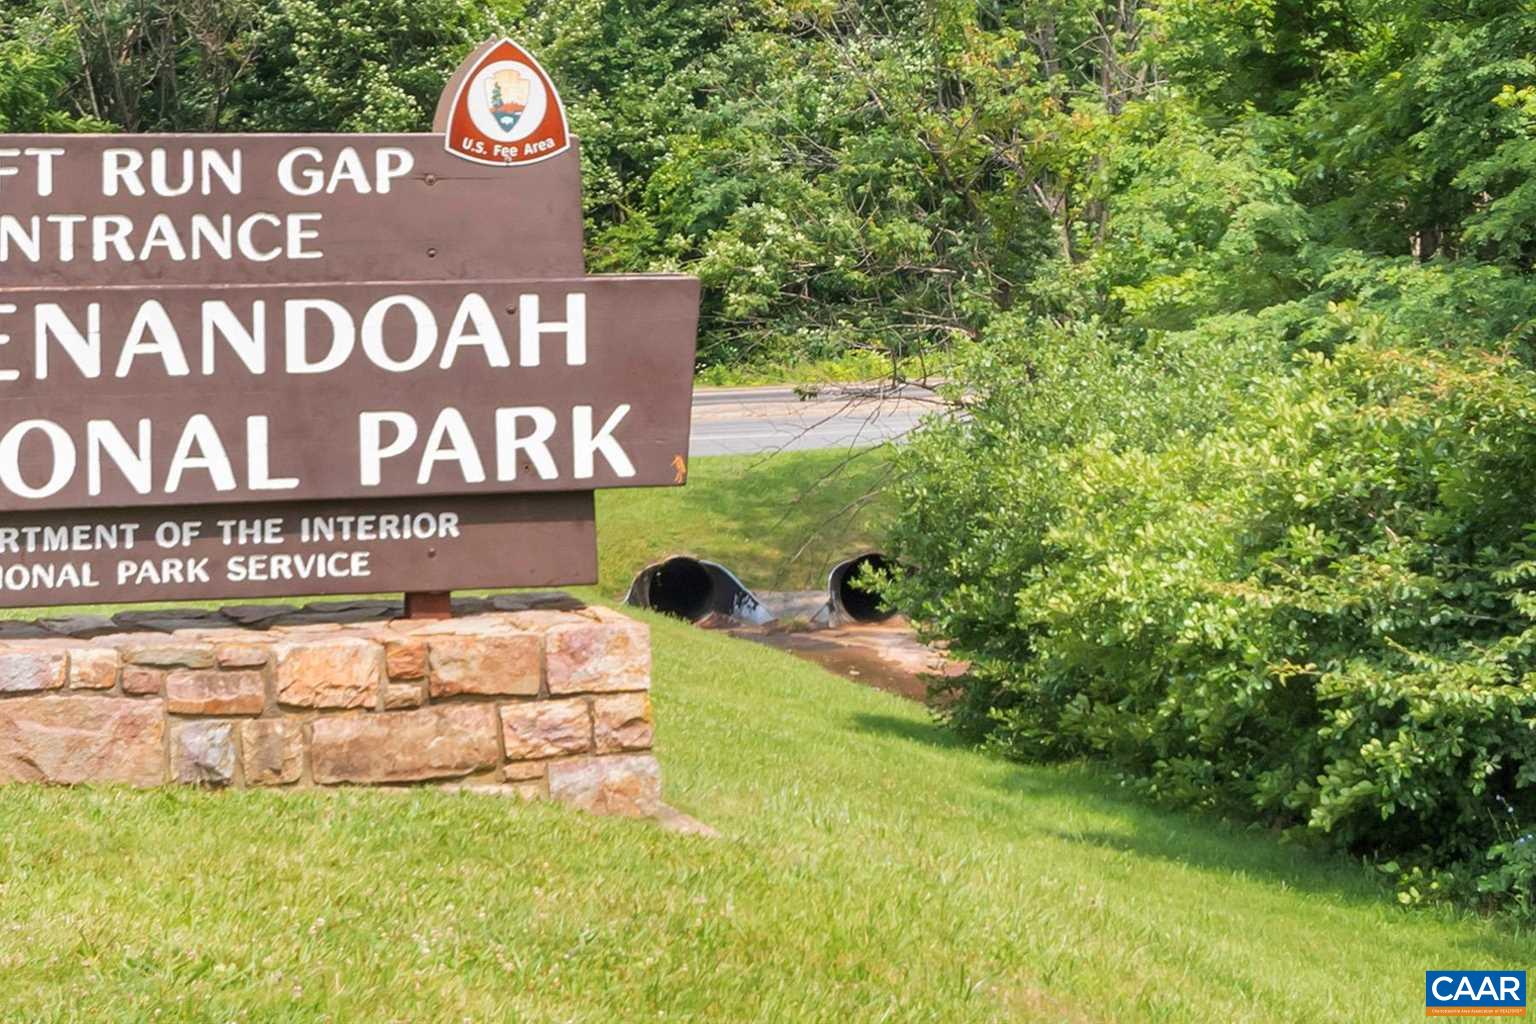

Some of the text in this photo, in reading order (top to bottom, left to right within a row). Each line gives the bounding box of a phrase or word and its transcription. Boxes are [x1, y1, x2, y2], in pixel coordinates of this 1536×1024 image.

[462, 137, 555, 157] U.S. Fee Area
[102, 148, 242, 197] RUN
[277, 147, 414, 196] GAP
[359, 404, 637, 486] PARK
[155, 521, 202, 549] OF
[217, 518, 285, 546] THE
[300, 512, 461, 544] INTERIOR
[117, 558, 211, 586] PARK
[226, 551, 372, 582] SERVICE
